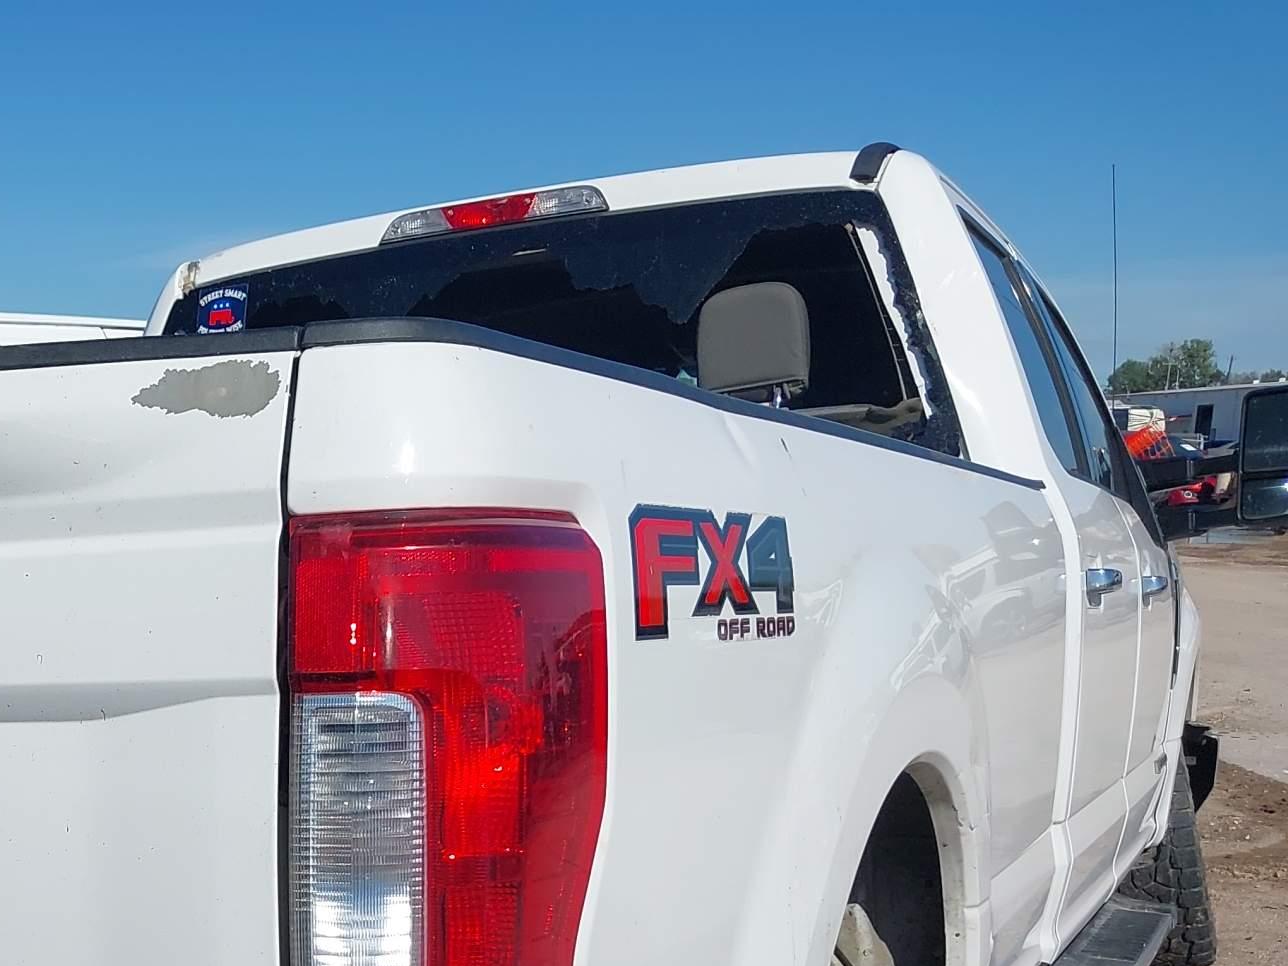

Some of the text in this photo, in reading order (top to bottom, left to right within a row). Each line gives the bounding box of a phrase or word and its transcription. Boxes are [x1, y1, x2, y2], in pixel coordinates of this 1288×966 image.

[628, 503, 795, 641] FX4
[717, 616, 795, 641] OFF ROAD
